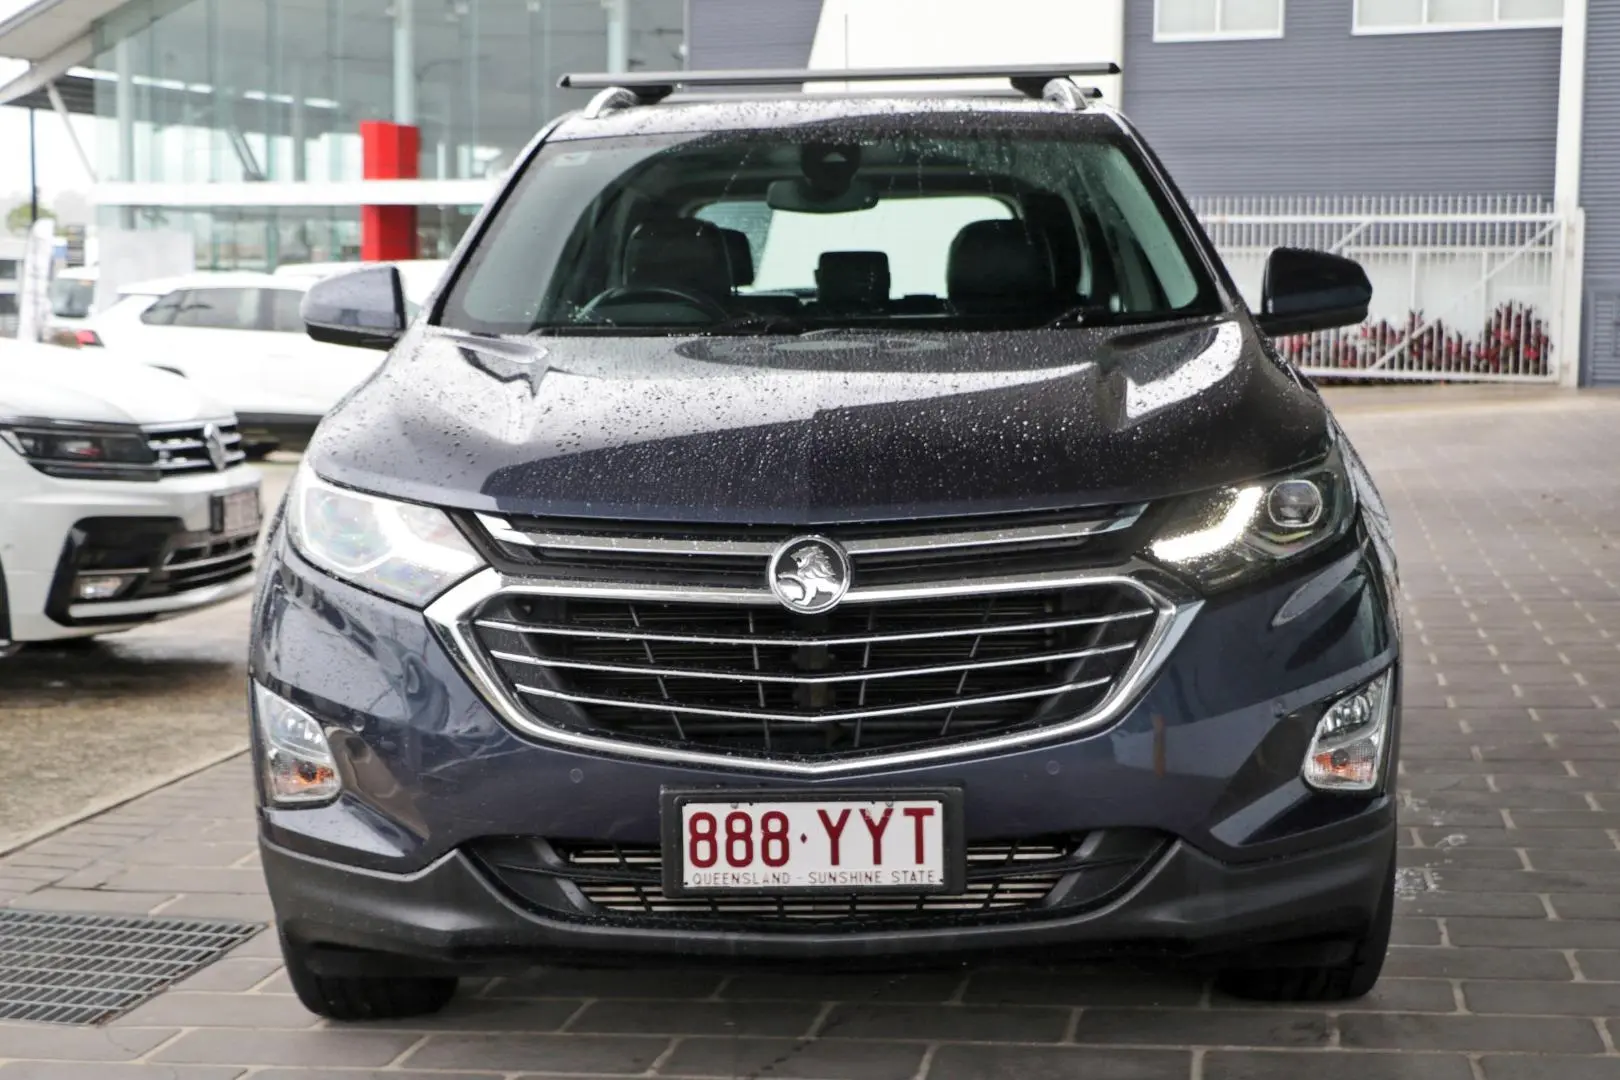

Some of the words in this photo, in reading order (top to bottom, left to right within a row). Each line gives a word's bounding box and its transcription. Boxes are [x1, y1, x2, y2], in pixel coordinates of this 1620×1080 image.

[692, 872, 792, 885] QUEENSLAND
[808, 870, 883, 884] SUNSHINE
[890, 869, 936, 883] STATE
